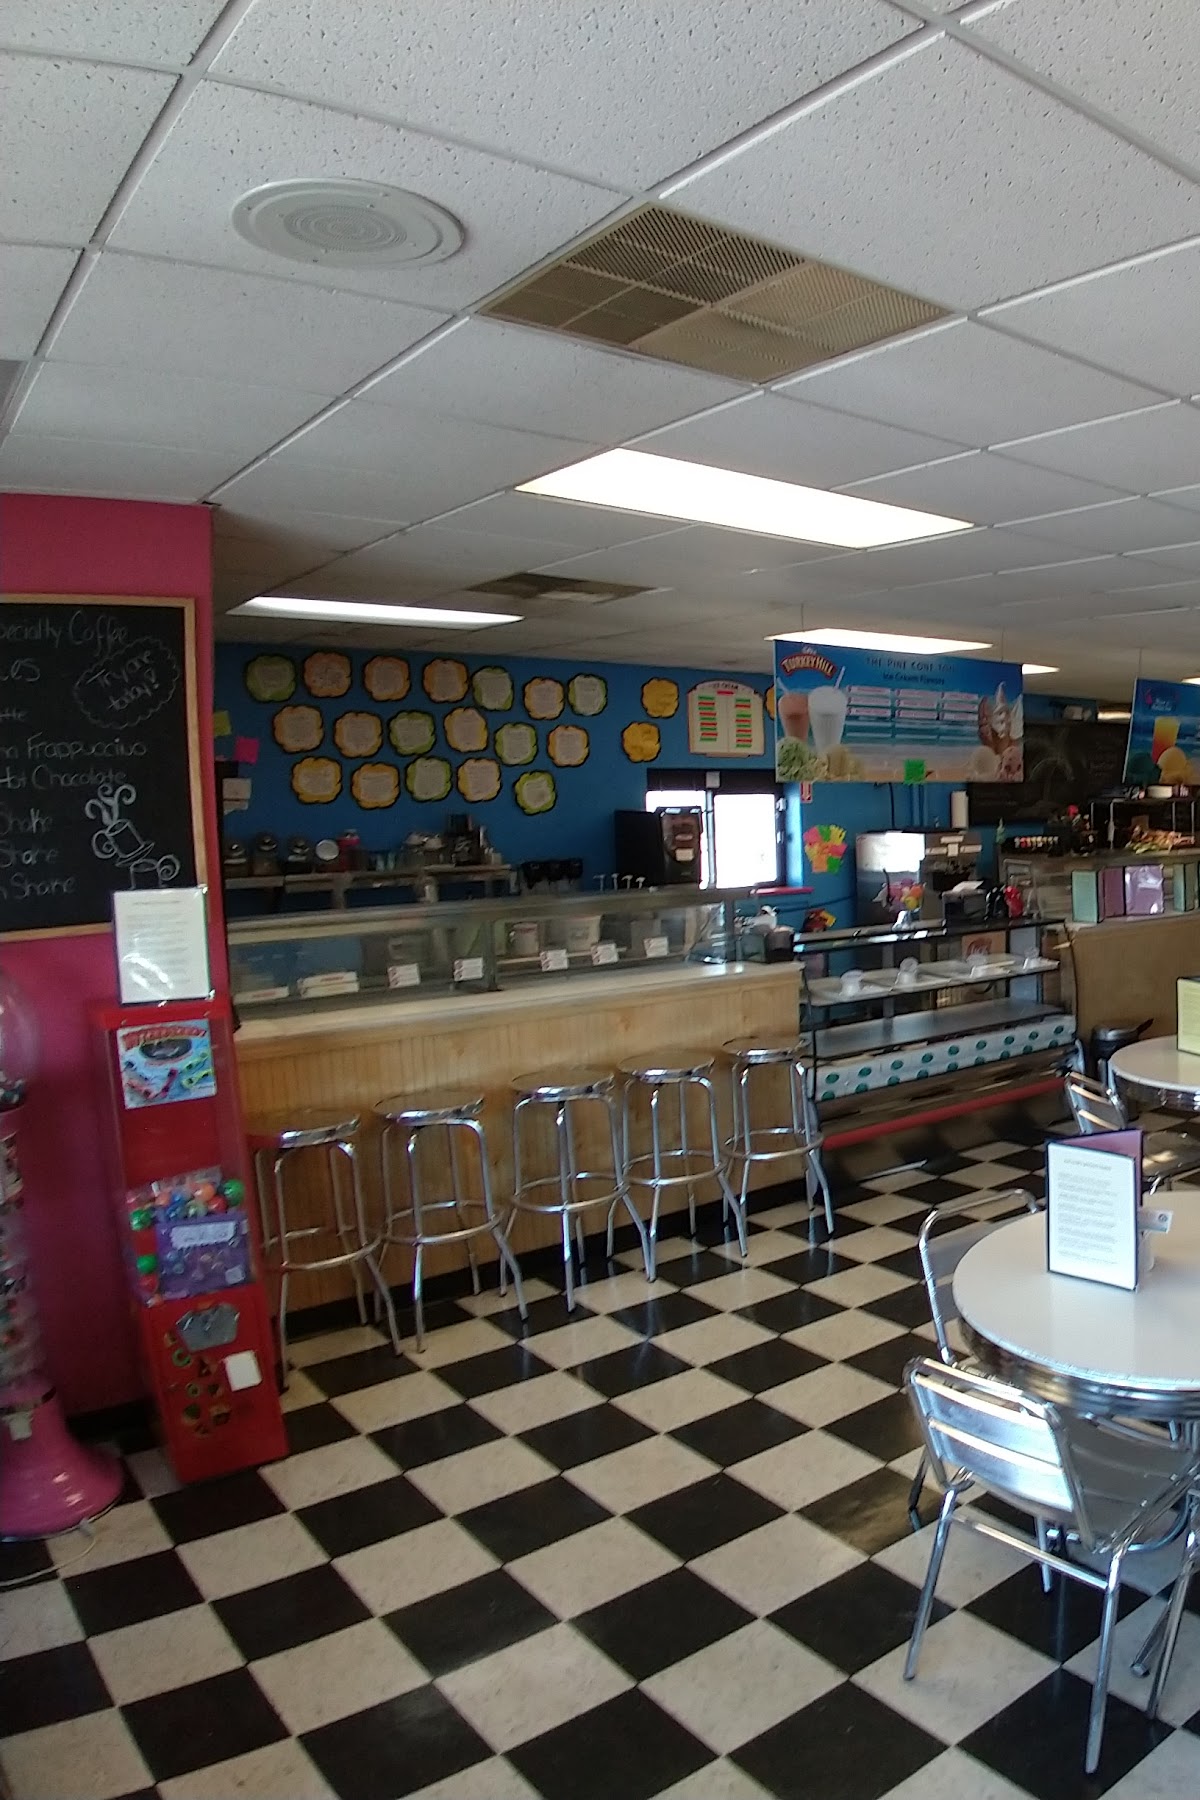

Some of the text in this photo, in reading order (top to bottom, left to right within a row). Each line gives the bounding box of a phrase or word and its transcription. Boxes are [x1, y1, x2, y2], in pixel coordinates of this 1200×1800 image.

[69, 610, 128, 657] Coffee
[781, 656, 833, 674] TURKEY HILL
[887, 659, 906, 670] PINE
[911, 661, 933, 672] CONE
[883, 673, 894, 681] Ice
[895, 672, 919, 683] Cream
